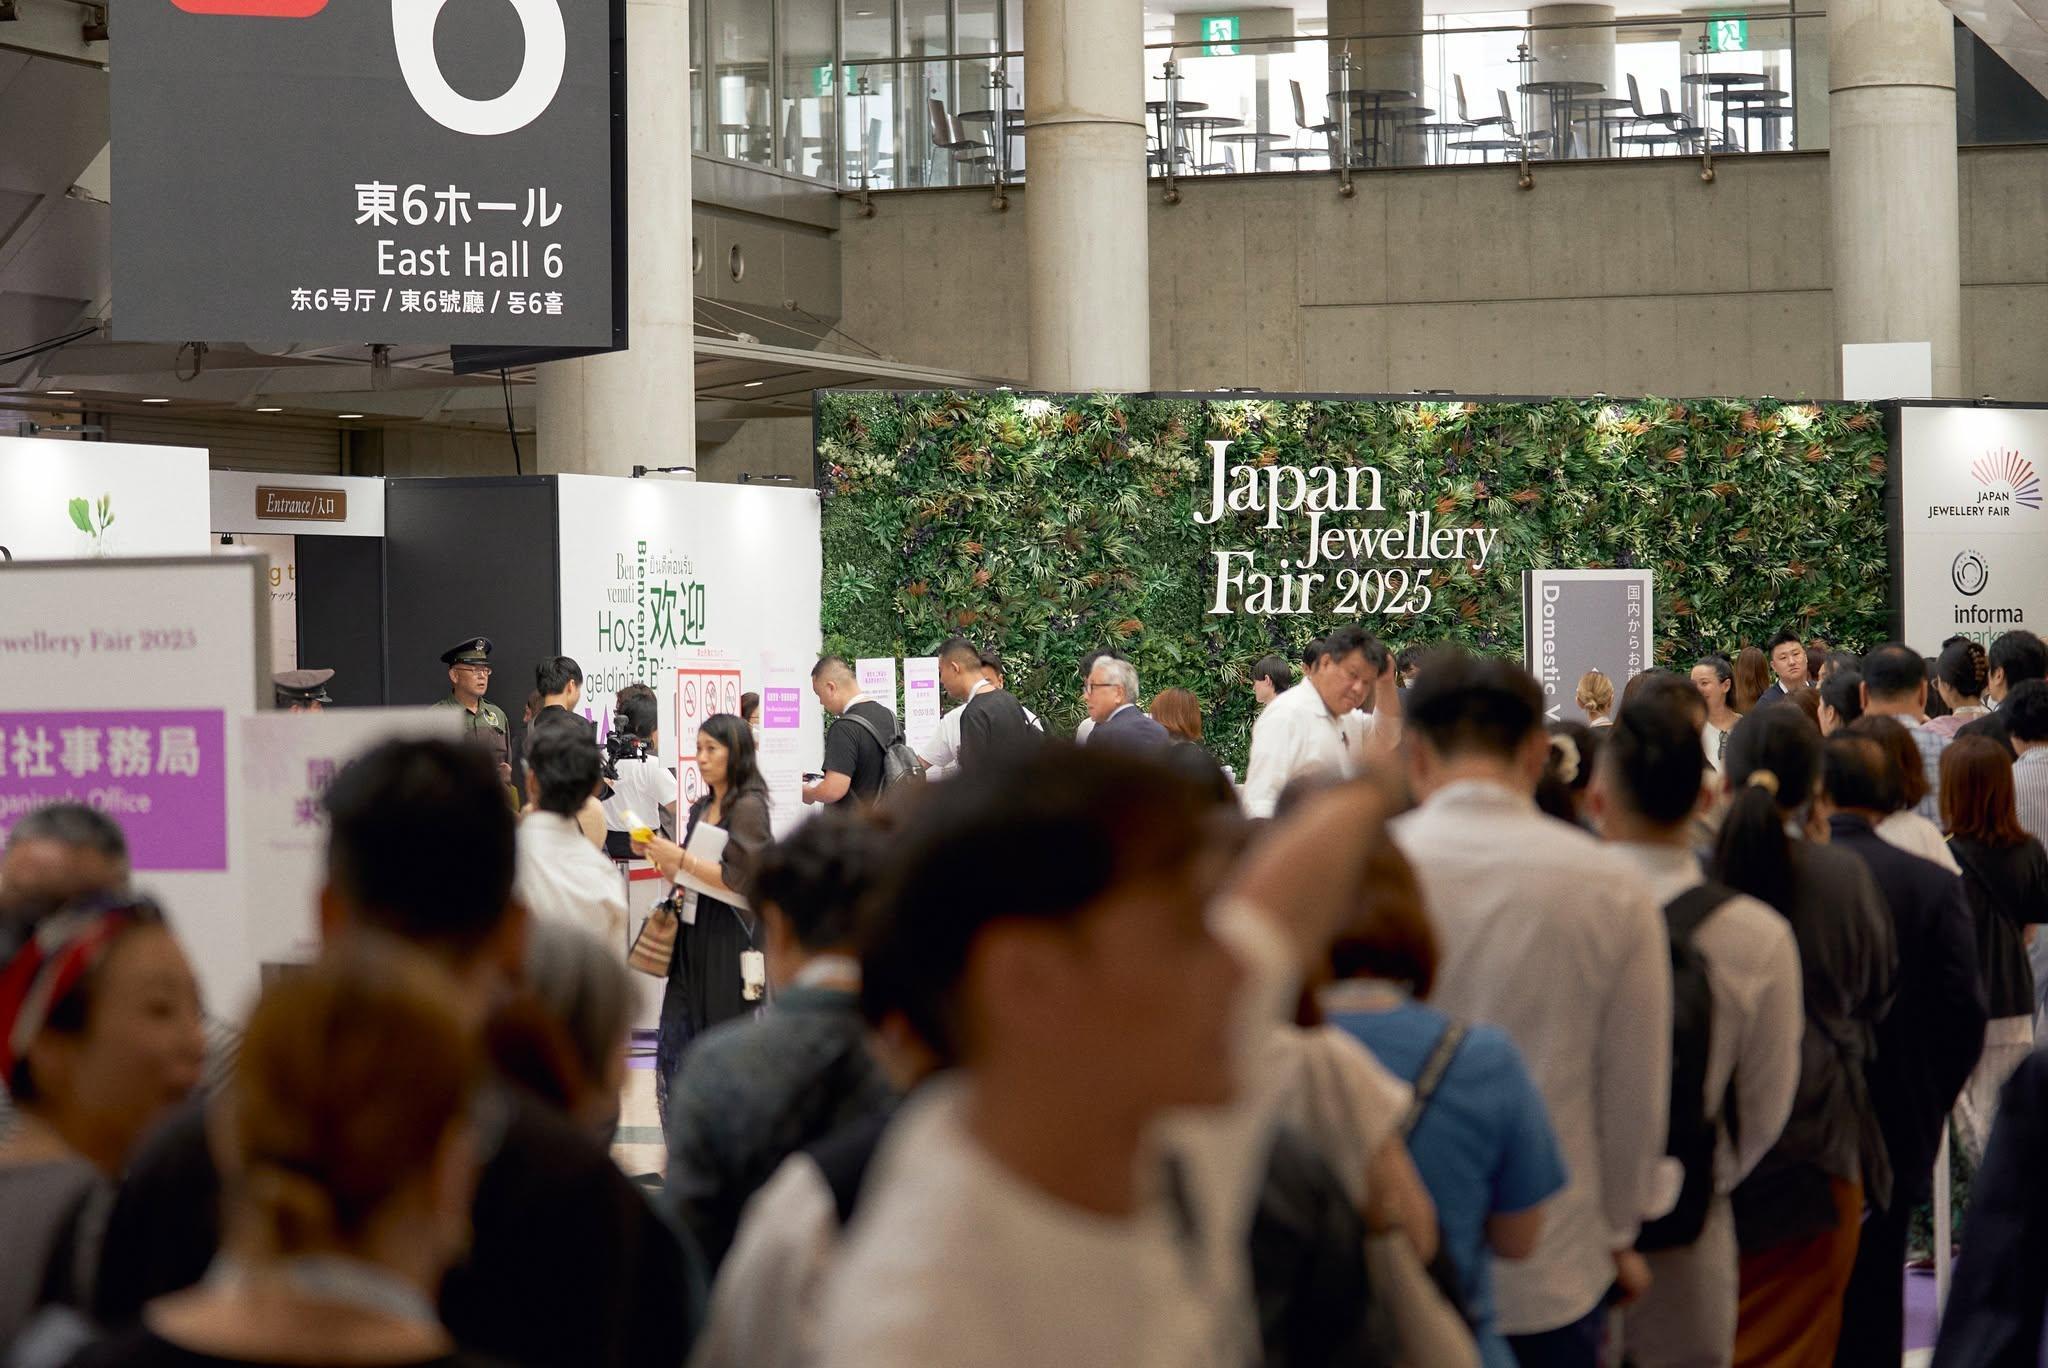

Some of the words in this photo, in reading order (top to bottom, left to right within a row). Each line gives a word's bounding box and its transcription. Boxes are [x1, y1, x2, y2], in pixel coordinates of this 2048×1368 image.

[354, 180, 563, 228] 東6ホール
[377, 240, 450, 276] East
[464, 240, 529, 278] Hall
[543, 243, 563, 278] 6
[291, 287, 376, 312] 东6号厅
[399, 289, 485, 314] 東6號廳
[507, 291, 564, 315] 동6홀
[1193, 440, 1386, 529] Japan
[1976, 491, 2010, 504] JAPAN
[1928, 506, 1985, 519] JEWELLERY
[1988, 506, 2011, 517] FAIR
[1296, 510, 1499, 570] Jewellery
[616, 552, 635, 580] Ben
[1208, 550, 1325, 614] Fair
[1332, 568, 1433, 614] 2025
[607, 582, 635, 603] venuti
[1954, 604, 2024, 624] informa
[650, 579, 706, 650] 欢迎
[89, 628, 134, 652] Fair
[138, 627, 197, 651] 2025
[598, 610, 635, 664] Hoş
[1543, 585, 1560, 695] Domestic
[0, 725, 200, 779] 社事務局
